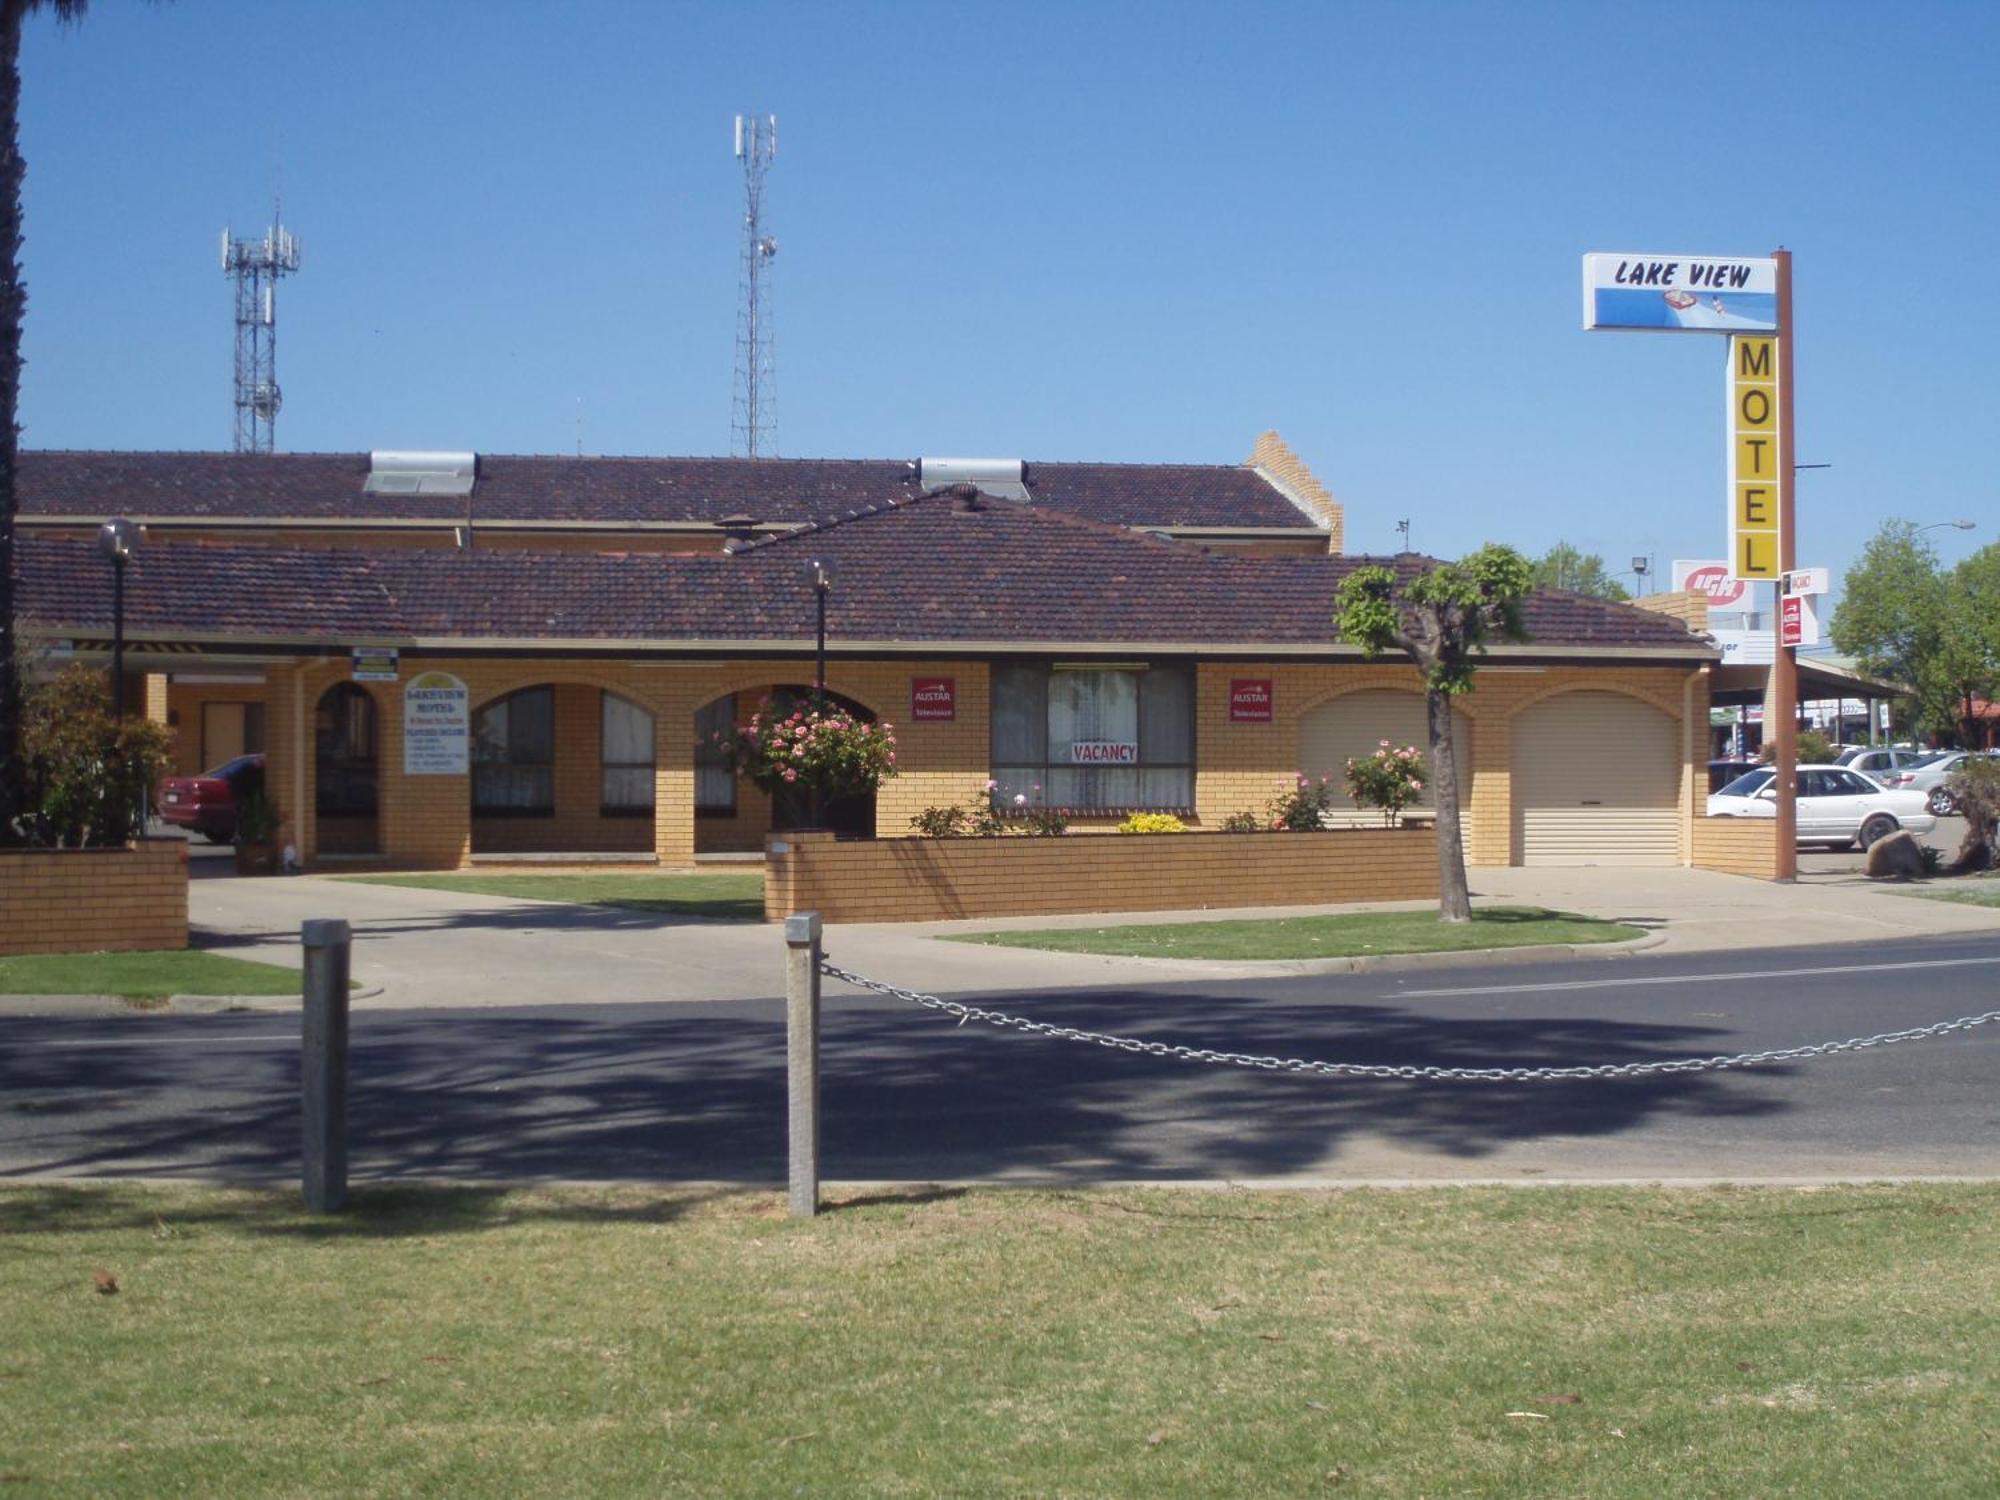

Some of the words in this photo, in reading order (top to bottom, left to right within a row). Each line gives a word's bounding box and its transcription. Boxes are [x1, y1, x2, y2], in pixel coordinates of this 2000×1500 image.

[1615, 261, 1678, 285] LAKE
[1689, 263, 1751, 288] VIEW
[1741, 342, 1769, 572] MOTEL
[915, 692, 950, 702] AUSTAR
[1233, 693, 1268, 703] AUSTAR
[1074, 743, 1136, 761] VACANCY
